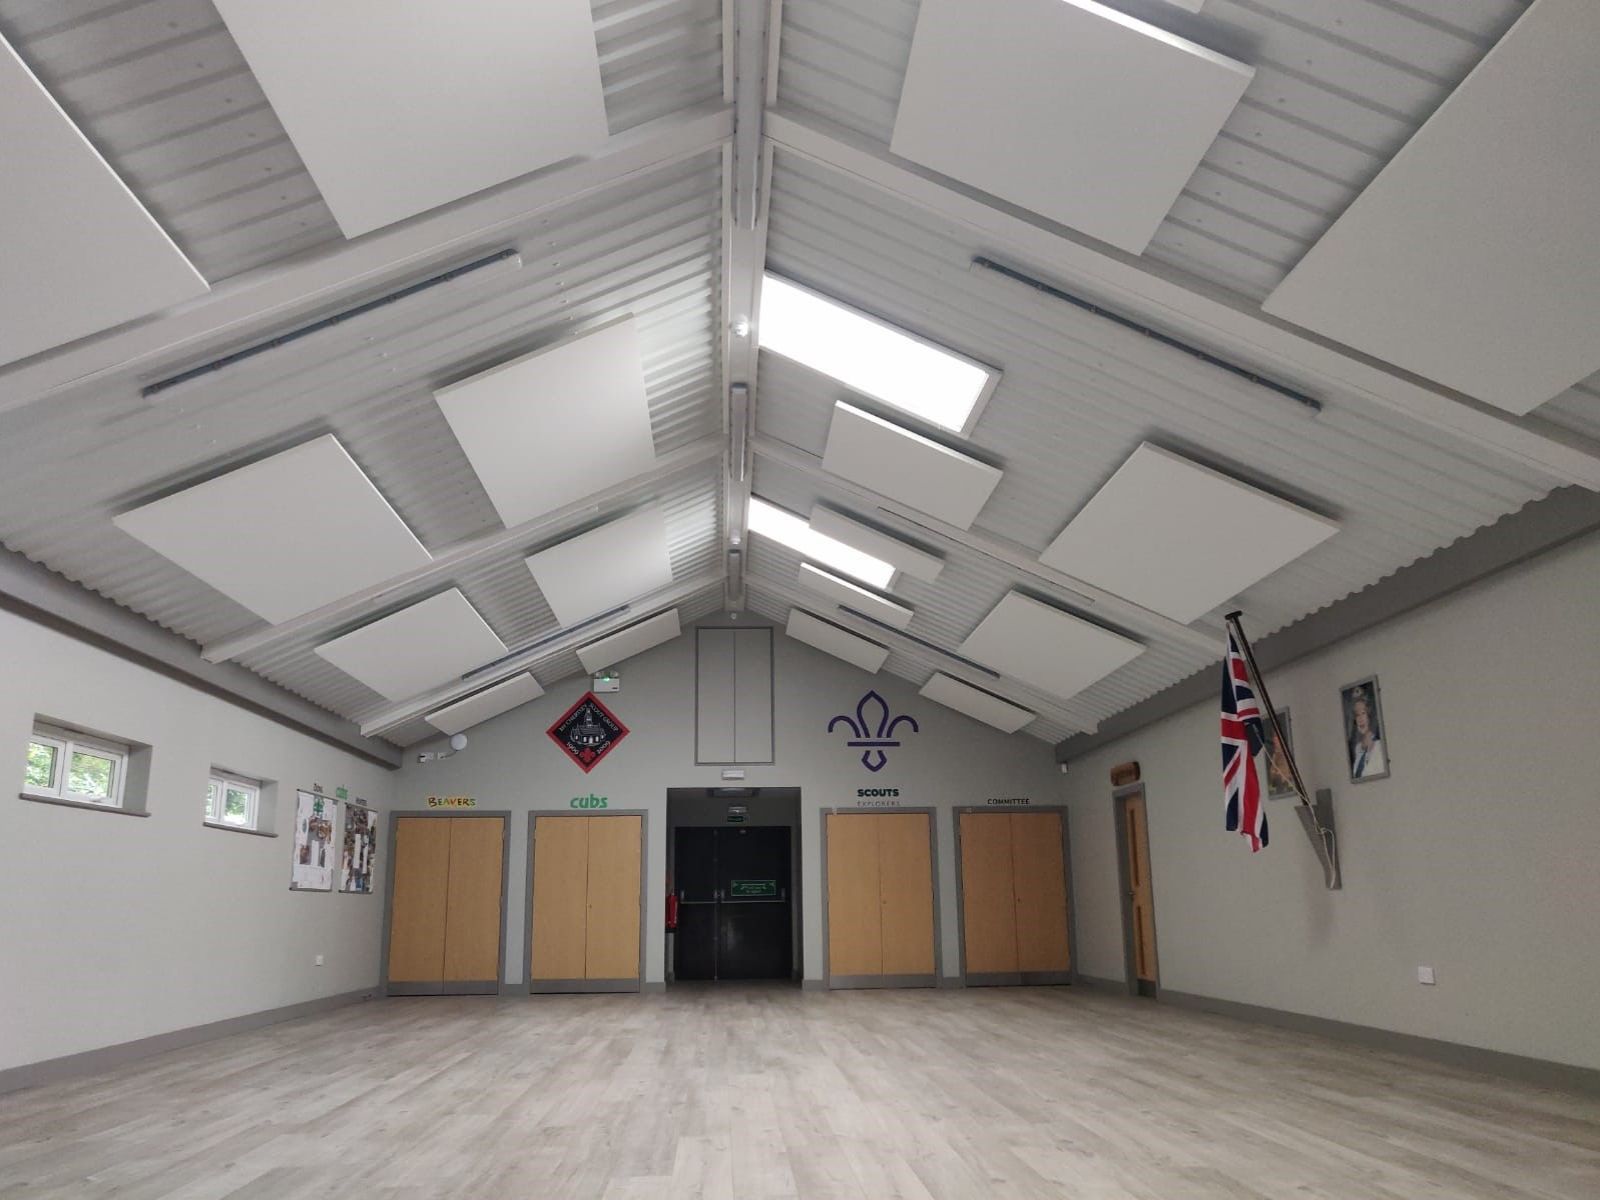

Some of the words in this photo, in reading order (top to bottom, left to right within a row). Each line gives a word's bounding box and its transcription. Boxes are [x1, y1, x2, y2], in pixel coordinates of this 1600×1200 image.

[602, 716, 619, 732] GROUP
[857, 788, 899, 797] SCOUTS
[428, 797, 476, 807] BEAVERS
[570, 793, 608, 808] cubs
